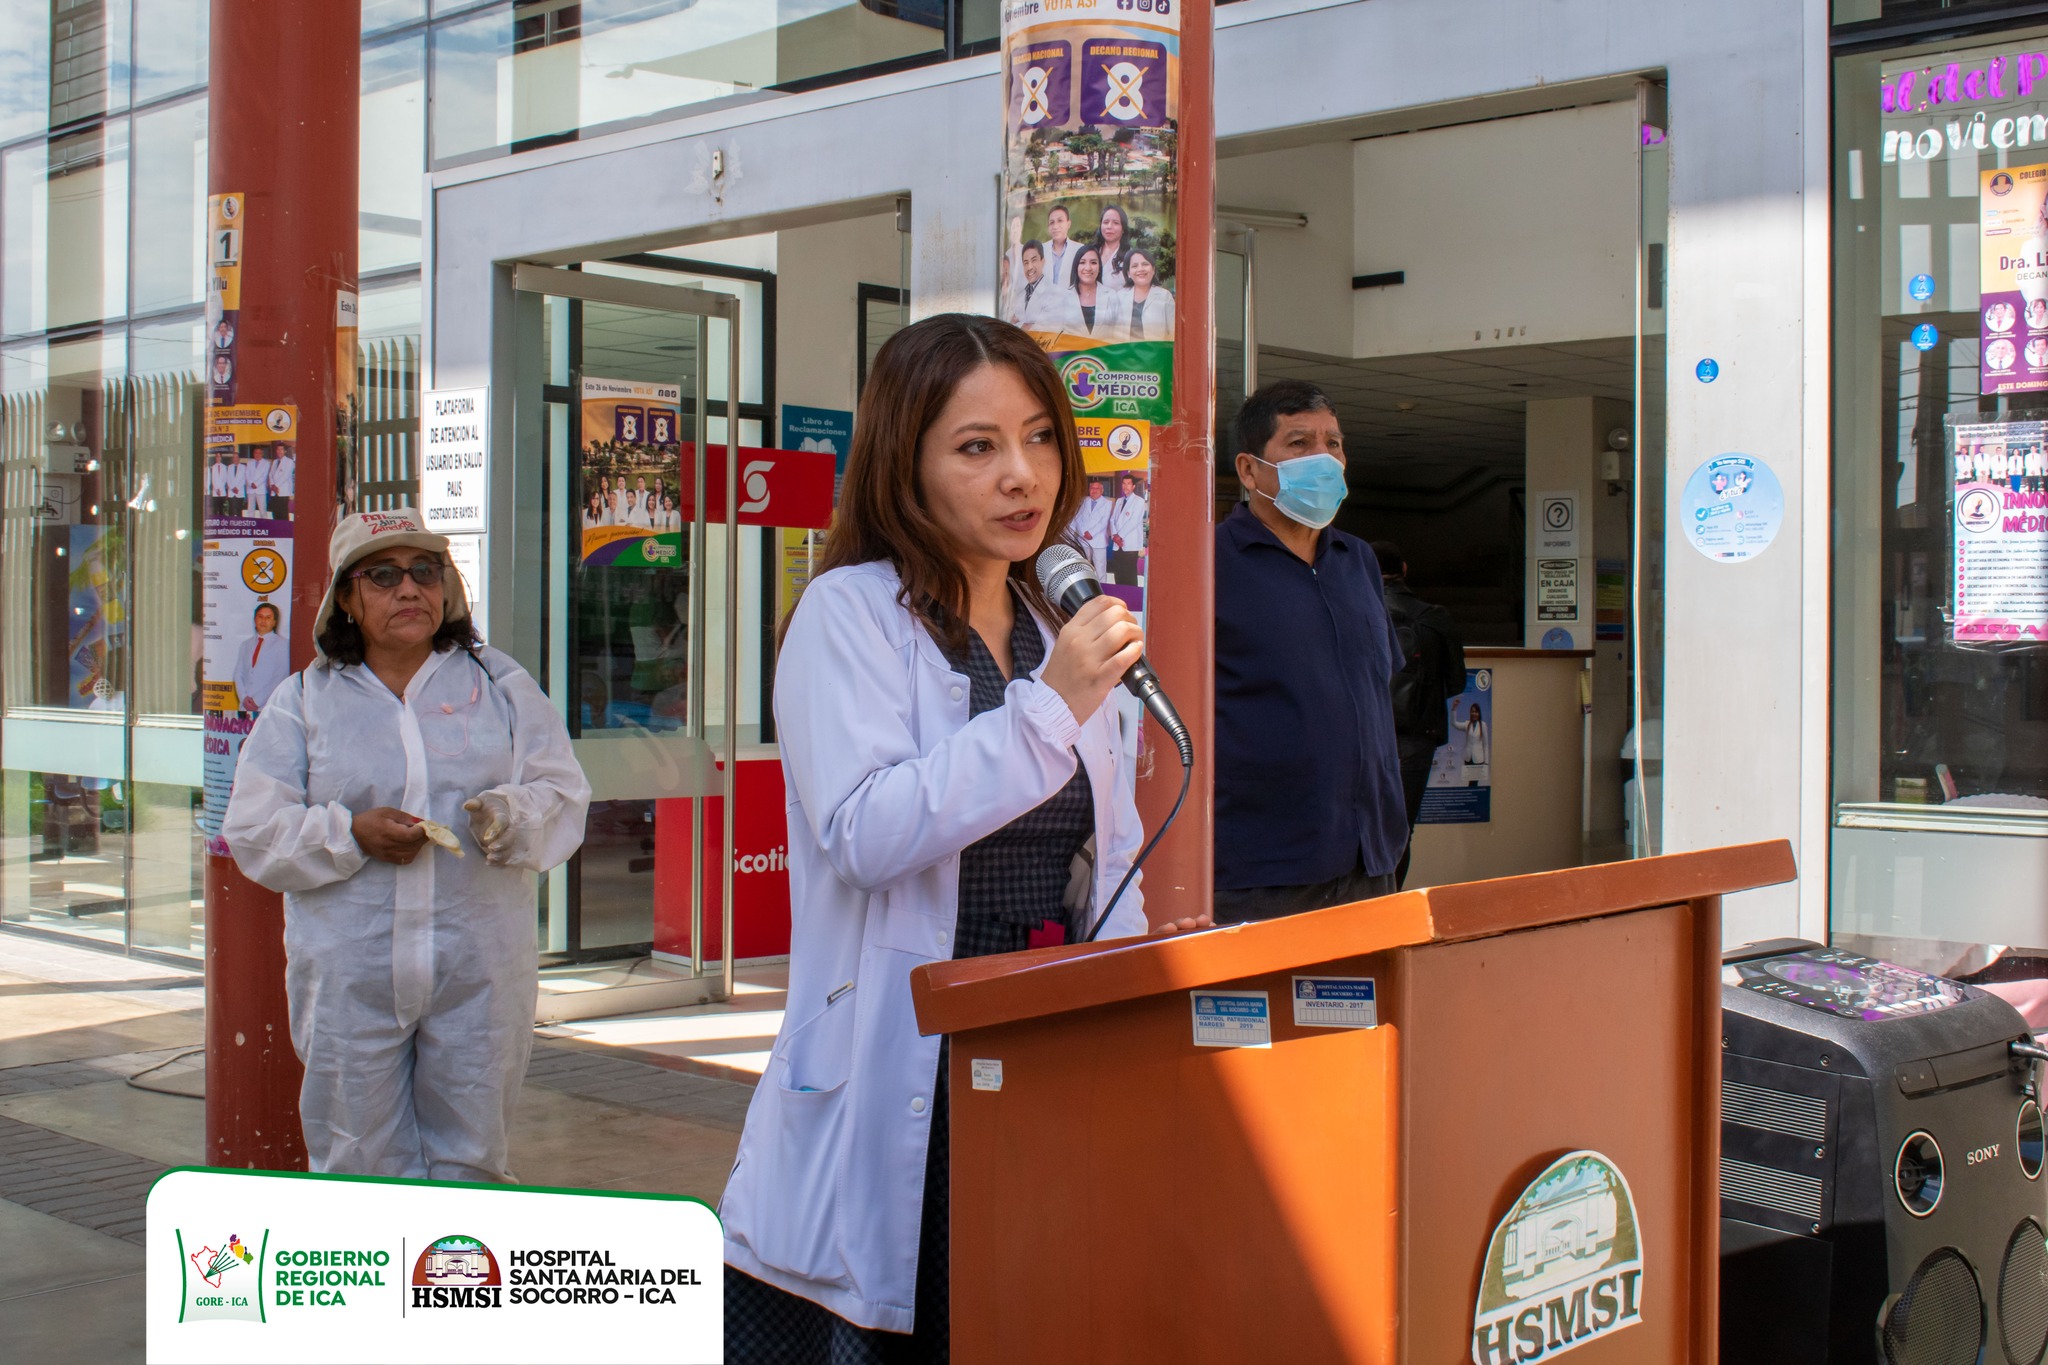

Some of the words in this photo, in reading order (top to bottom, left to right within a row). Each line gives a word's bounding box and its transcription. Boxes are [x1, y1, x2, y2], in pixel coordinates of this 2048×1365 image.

[1032, 48, 1064, 61] NACIONAL
[1090, 46, 1122, 56] DECANO
[1123, 47, 1159, 59] REGIONAL
[2019, 169, 2047, 180] COLEGIO
[219, 232, 232, 260] 1
[1999, 255, 2030, 271] Dra.
[1097, 373, 1159, 382] COMPROMISO
[585, 383, 595, 391] Este
[608, 385, 632, 394] Noviembre
[1097, 381, 1158, 398] MÉDICO
[436, 398, 475, 416] PLATAFORMA
[1115, 402, 1137, 412] ICA
[802, 417, 822, 425] Libro
[430, 427, 439, 444] DE
[440, 425, 470, 443] ATENCION
[471, 424, 479, 441] AL
[789, 424, 847, 436] Reclamaciones
[426, 454, 453, 471] USUARIO
[454, 453, 463, 470] EN
[463, 452, 483, 469] SALUD
[447, 481, 462, 498] PAUS
[428, 507, 451, 522] (COSTADO
[452, 506, 458, 520] DE
[459, 506, 474, 519] RAYOS
[229, 519, 257, 527] nuestro
[1540, 580, 1552, 588] EN
[1967, 1144, 2000, 1165] SONY
[1475, 1269, 1641, 1365] HSMSI
